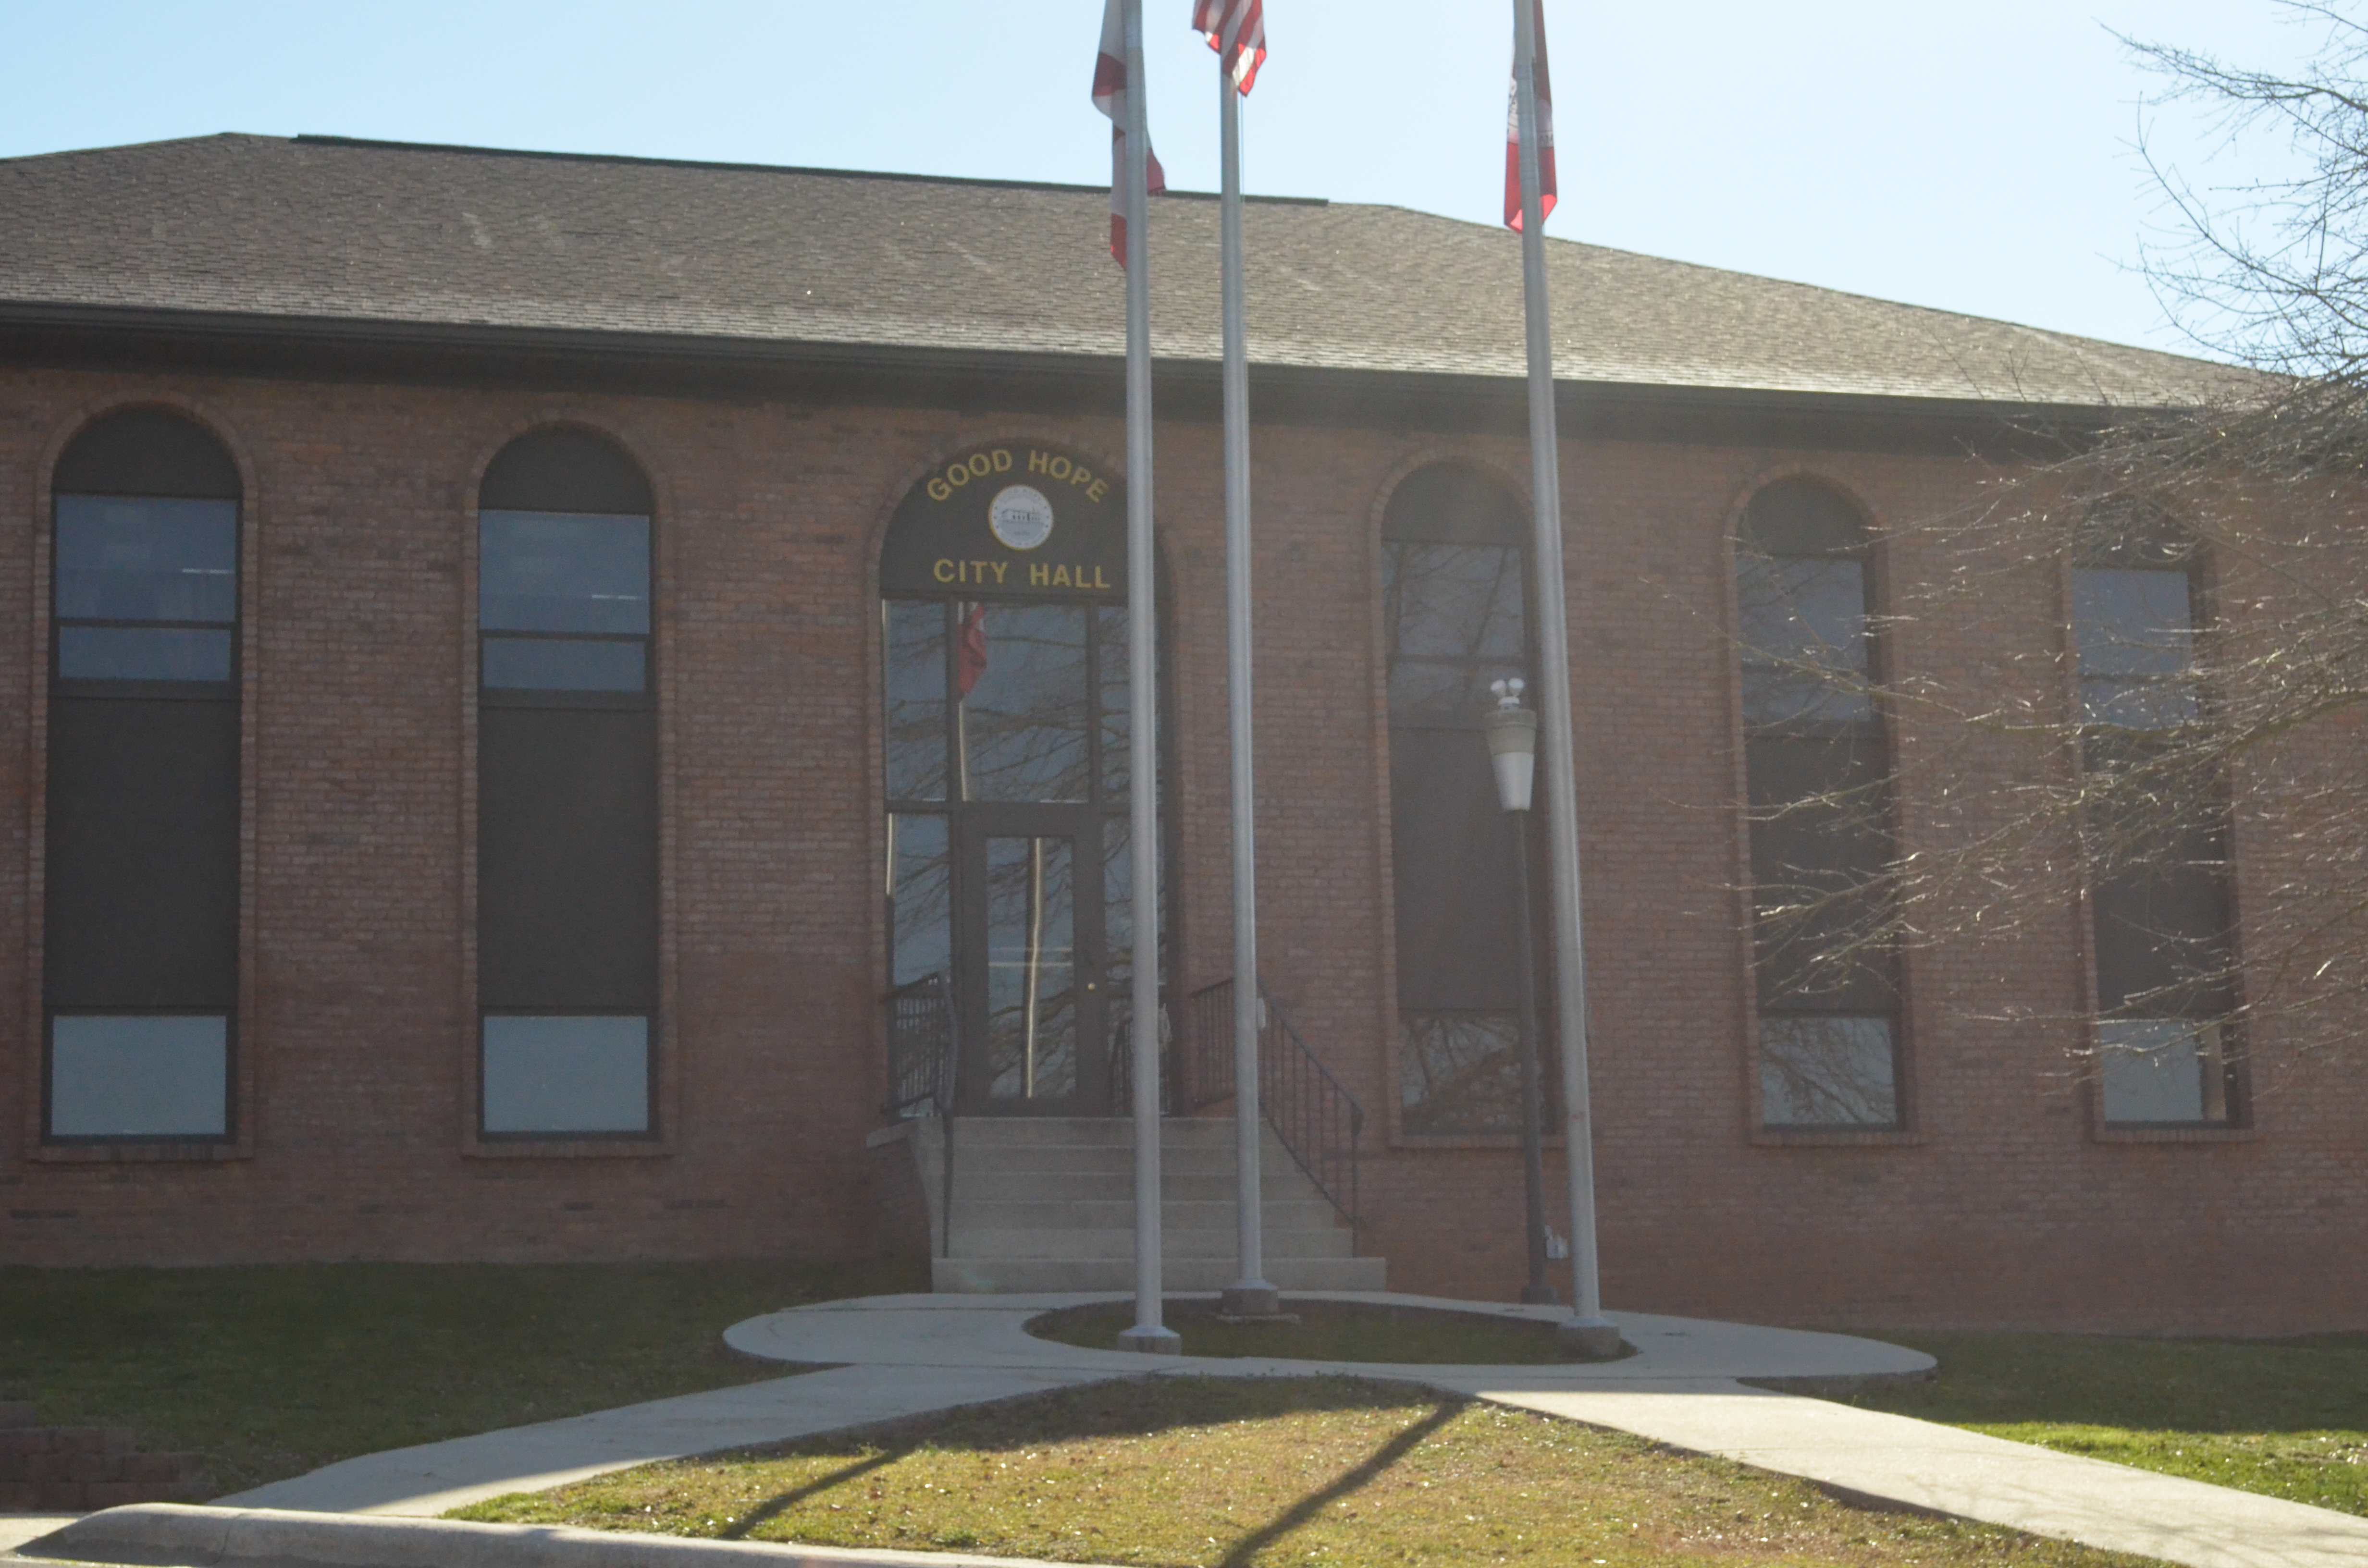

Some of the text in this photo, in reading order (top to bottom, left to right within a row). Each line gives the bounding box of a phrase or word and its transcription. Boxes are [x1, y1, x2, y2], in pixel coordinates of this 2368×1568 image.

[927, 449, 1012, 501] GOOD
[1028, 450, 1110, 502] HOPE
[933, 559, 1111, 589] CITY HALL
